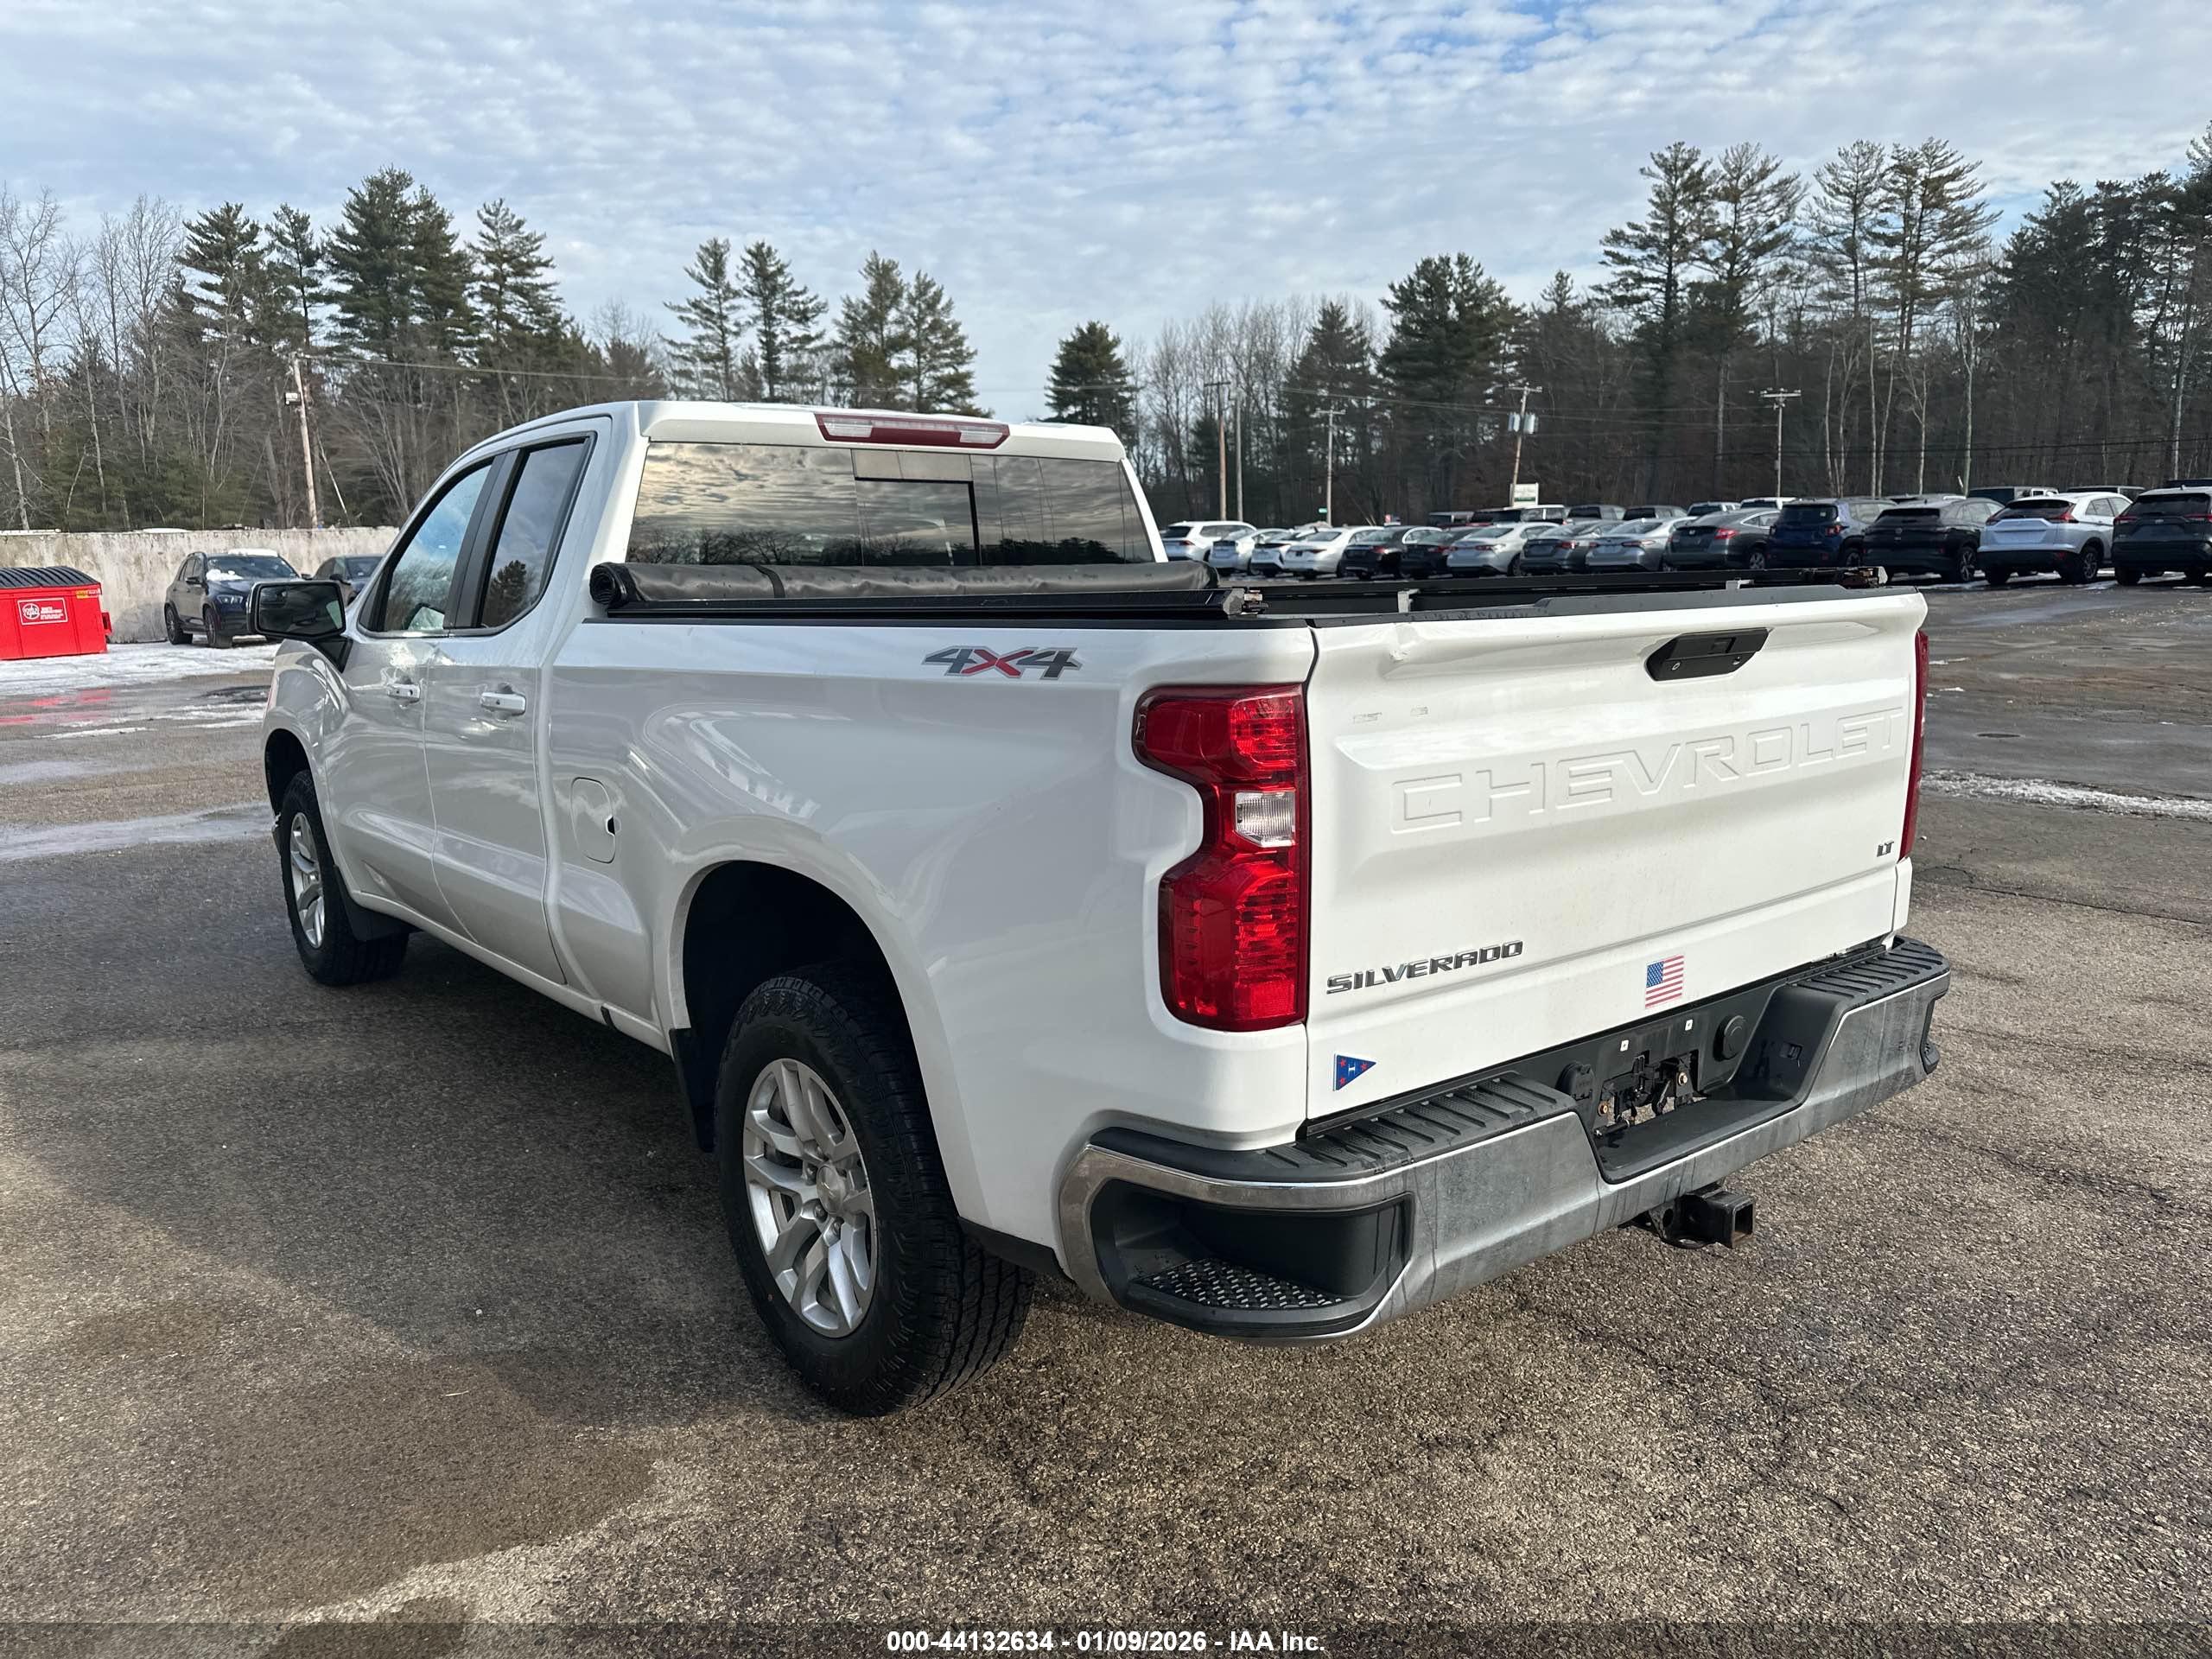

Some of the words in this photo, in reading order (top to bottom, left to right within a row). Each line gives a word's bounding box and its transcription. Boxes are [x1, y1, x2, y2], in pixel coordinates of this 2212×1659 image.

[1391, 707, 1904, 834] CHEVROLET
[1876, 841, 1895, 857] LT
[1326, 939, 1523, 995] SILVERADO
